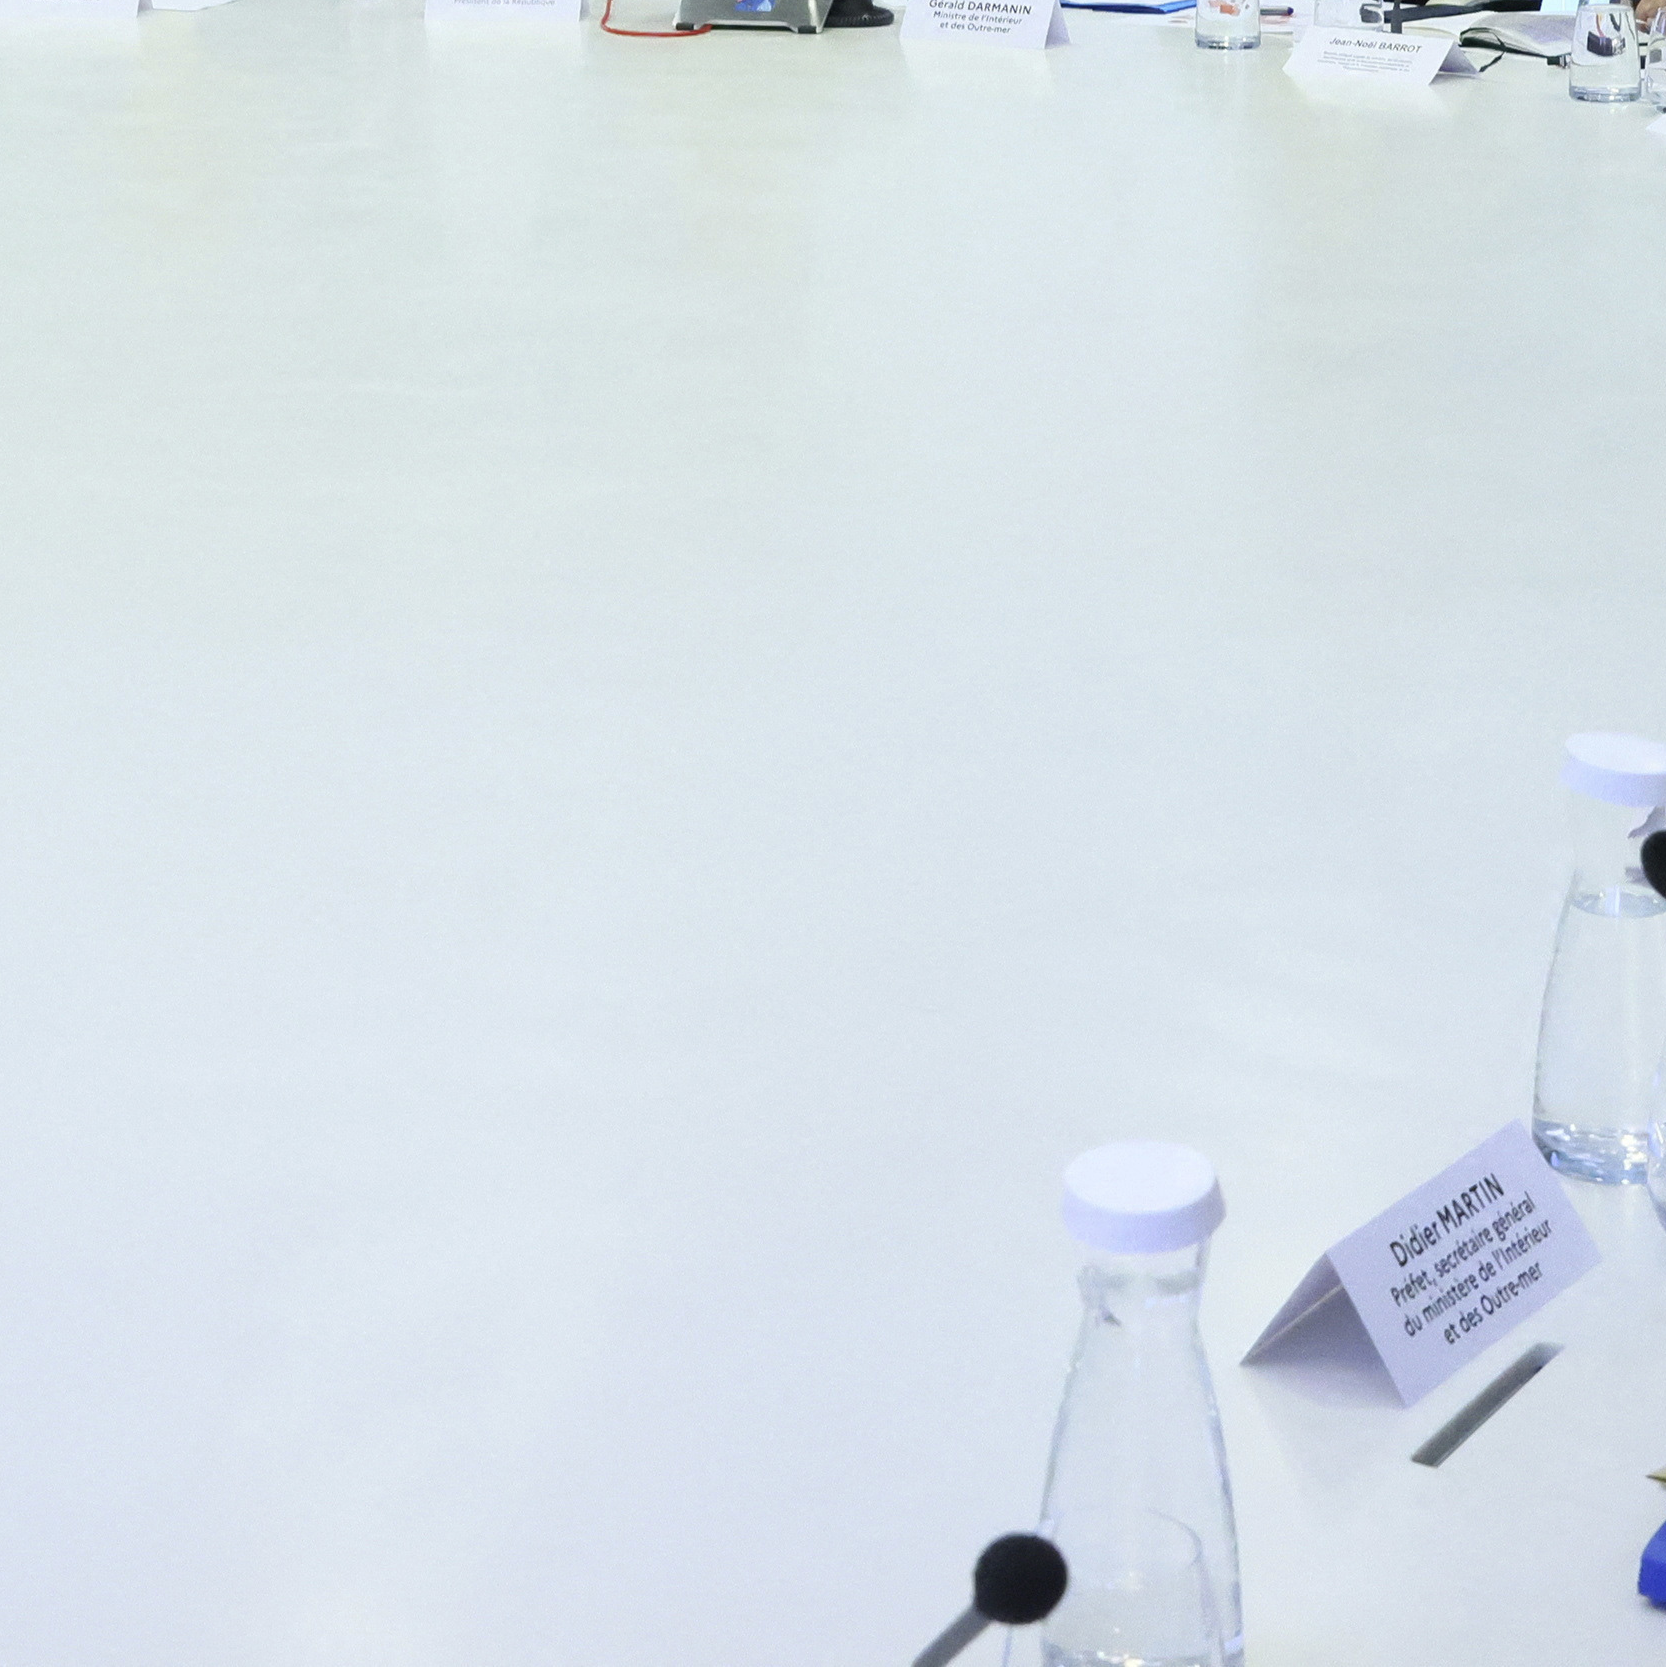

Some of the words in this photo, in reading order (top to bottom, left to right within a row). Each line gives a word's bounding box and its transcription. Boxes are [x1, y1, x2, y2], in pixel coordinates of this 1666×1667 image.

[933, 10, 967, 21] Ministre
[968, 13, 979, 22] de
[950, 22, 965, 30] des
[967, 24, 1011, 34] Outre-mer
[967, 1, 1032, 15] DARMANIN
[1330, 37, 1377, 49] Jean-Noël
[1378, 42, 1422, 53] BARROT
[1389, 1221, 1442, 1268] Didier
[1436, 1172, 1505, 1235] MARTIN
[1390, 1269, 1437, 1308] Préfet,
[1433, 1227, 1494, 1281] secrétaire
[1492, 1190, 1537, 1243] général
[1403, 1312, 1424, 1338] du
[1422, 1272, 1478, 1325] ministère
[1477, 1256, 1497, 1284] de
[1493, 1218, 1553, 1271] l'Intérieur
[1443, 1327, 1458, 1346] et
[1458, 1307, 1485, 1334] des
[1480, 1259, 1544, 1317] Outre-mer
